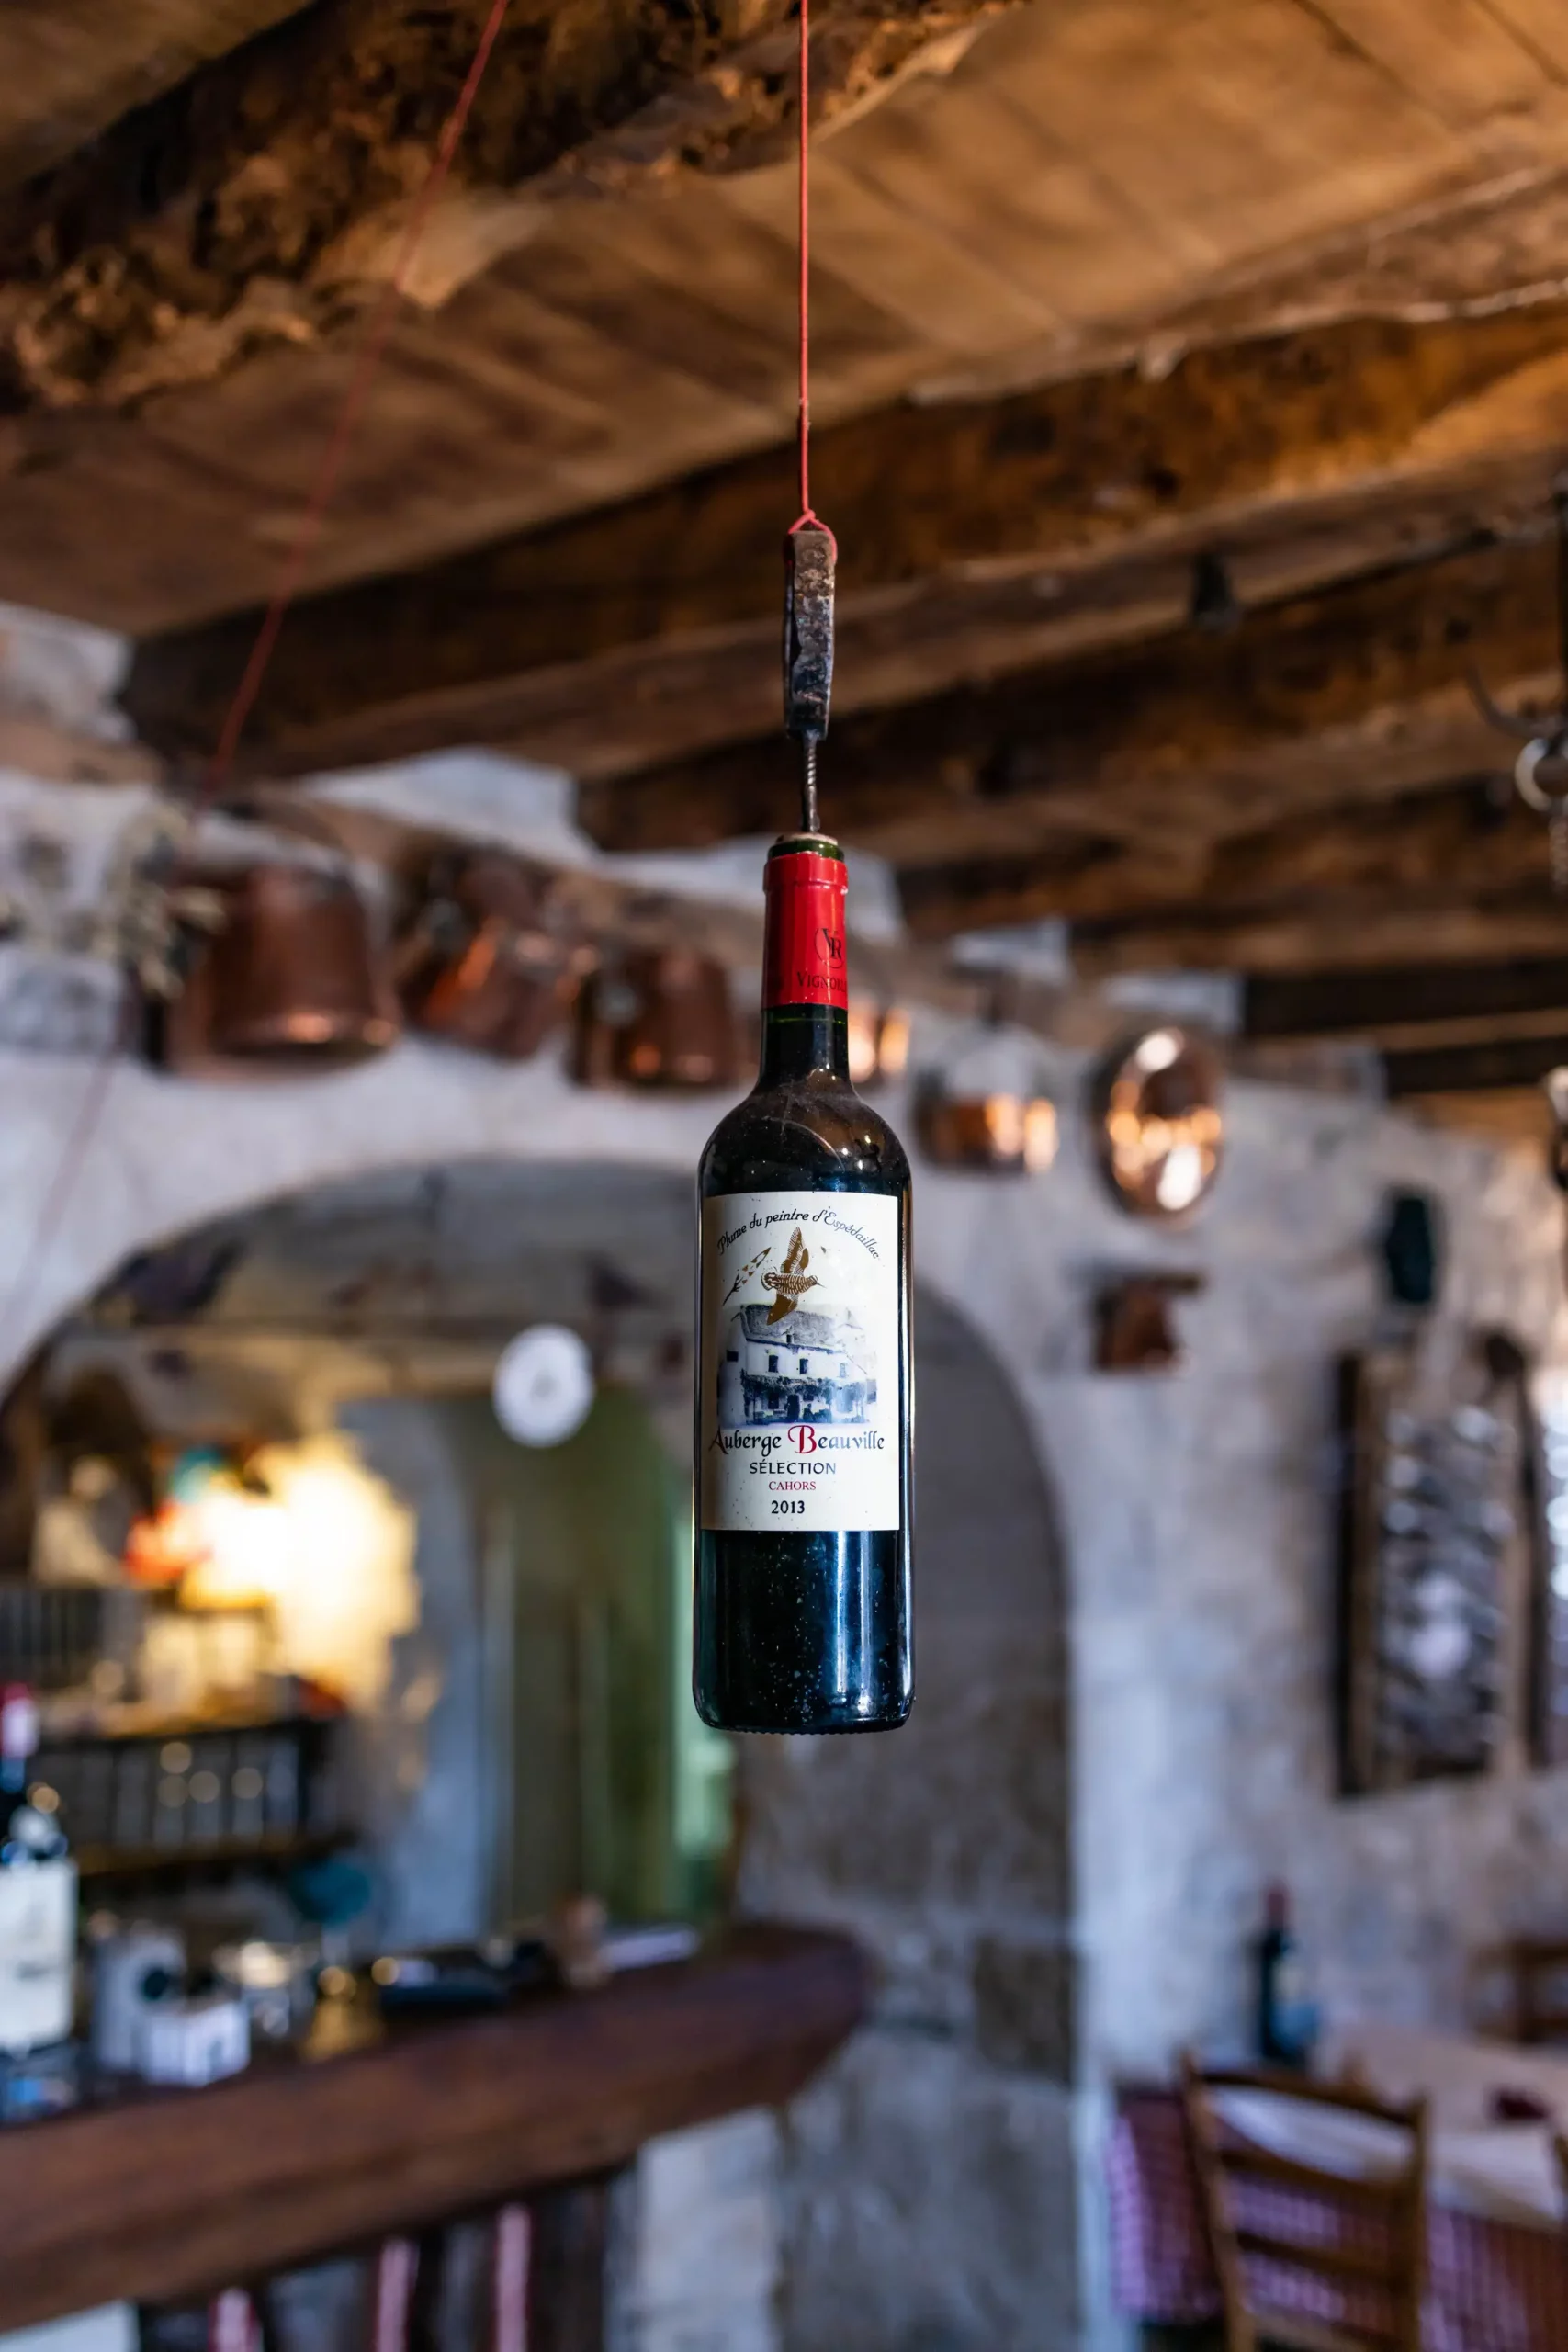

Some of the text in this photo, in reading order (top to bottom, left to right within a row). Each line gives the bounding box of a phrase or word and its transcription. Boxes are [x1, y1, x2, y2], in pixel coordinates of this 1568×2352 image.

[717, 1225, 747, 1255] Plume
[750, 1212, 762, 1229] du
[764, 1208, 809, 1228] peintre
[708, 1425, 885, 1457] Auberge Beauville
[750, 1459, 836, 1475] SÉLECTION
[768, 1481, 817, 1491] CAHORS
[771, 1500, 806, 1514] 2013
